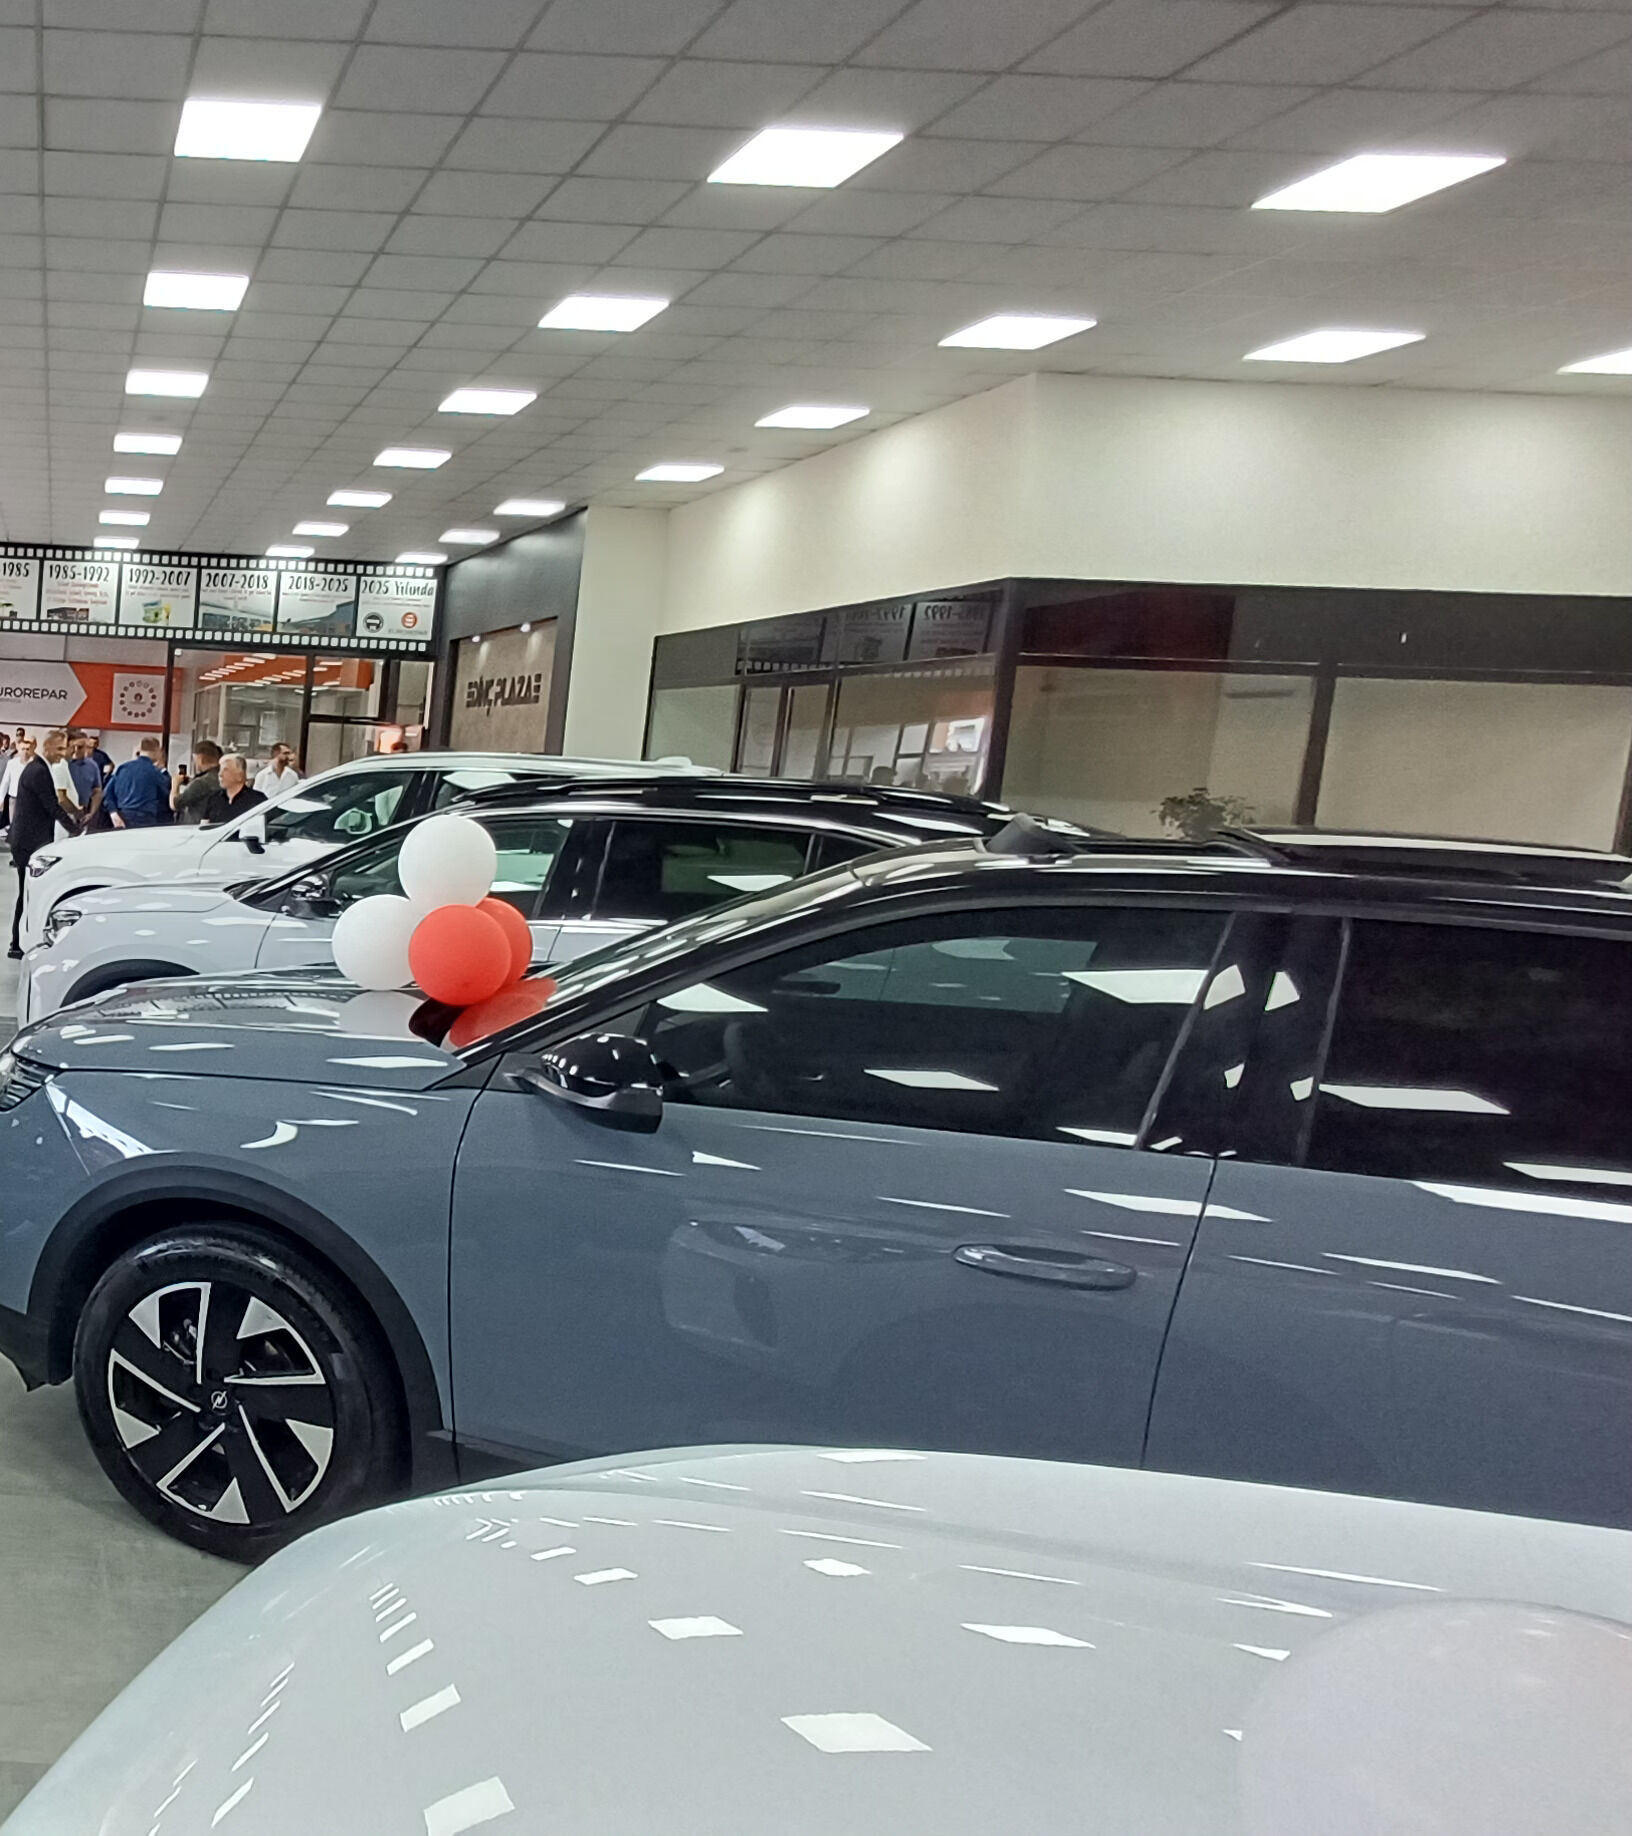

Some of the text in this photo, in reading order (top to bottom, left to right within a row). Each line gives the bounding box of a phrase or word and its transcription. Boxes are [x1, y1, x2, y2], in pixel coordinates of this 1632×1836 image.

[48, 564, 111, 582] 1985-1992
[129, 568, 191, 586] 1992-2007
[205, 572, 269, 590] 2007-2018
[288, 575, 349, 593] 2018-2025
[361, 579, 390, 595] 2025
